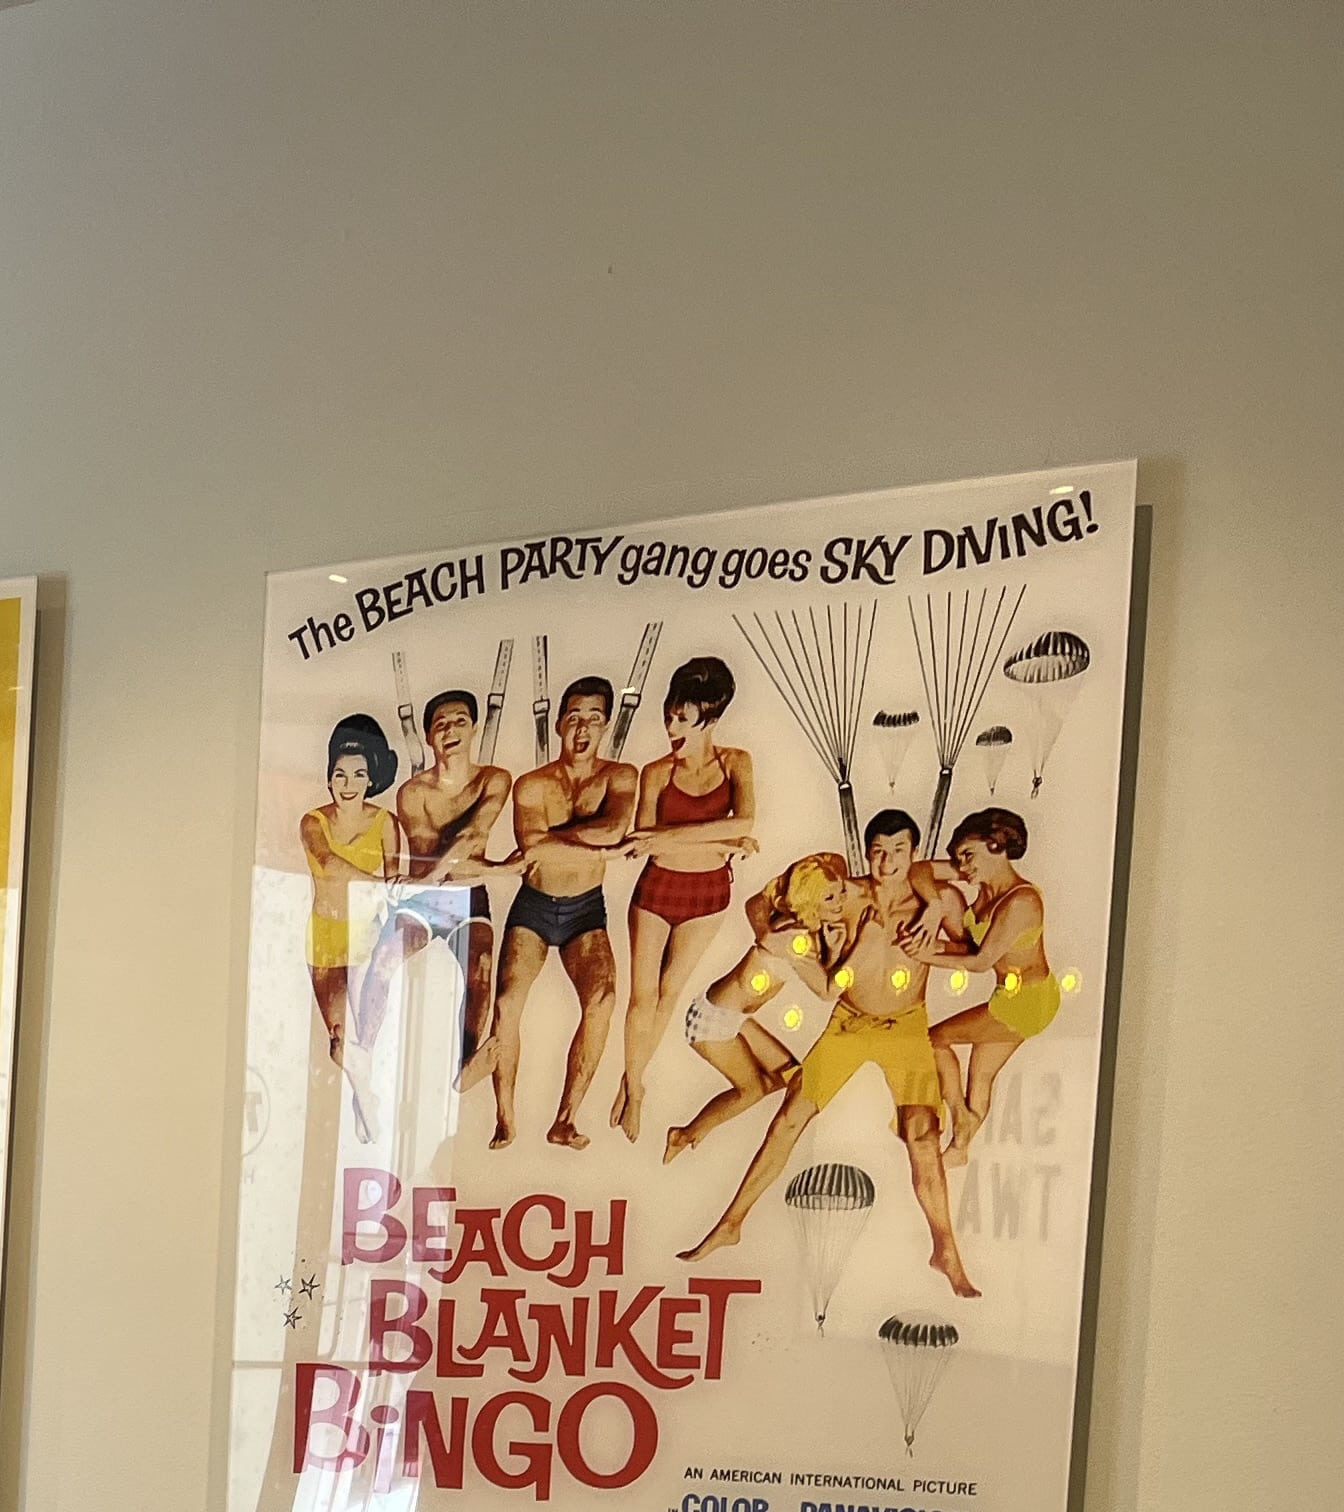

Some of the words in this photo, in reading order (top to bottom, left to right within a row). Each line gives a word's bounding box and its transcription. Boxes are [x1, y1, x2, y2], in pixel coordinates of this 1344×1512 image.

[288, 613, 355, 660] The
[355, 554, 485, 632] BEACH
[500, 535, 624, 590] PARTY
[618, 540, 717, 588] gang
[718, 547, 812, 588] goes
[820, 535, 912, 585] SKY
[923, 491, 1099, 576] DIVING!
[341, 1167, 628, 1287] BEACH
[368, 1279, 761, 1391] BLANKET
[684, 1467, 703, 1480] AN
[710, 1469, 782, 1485] AMERICAN
[790, 1473, 904, 1492] INTERNATIONAL
[912, 1479, 977, 1495] PICTURE
